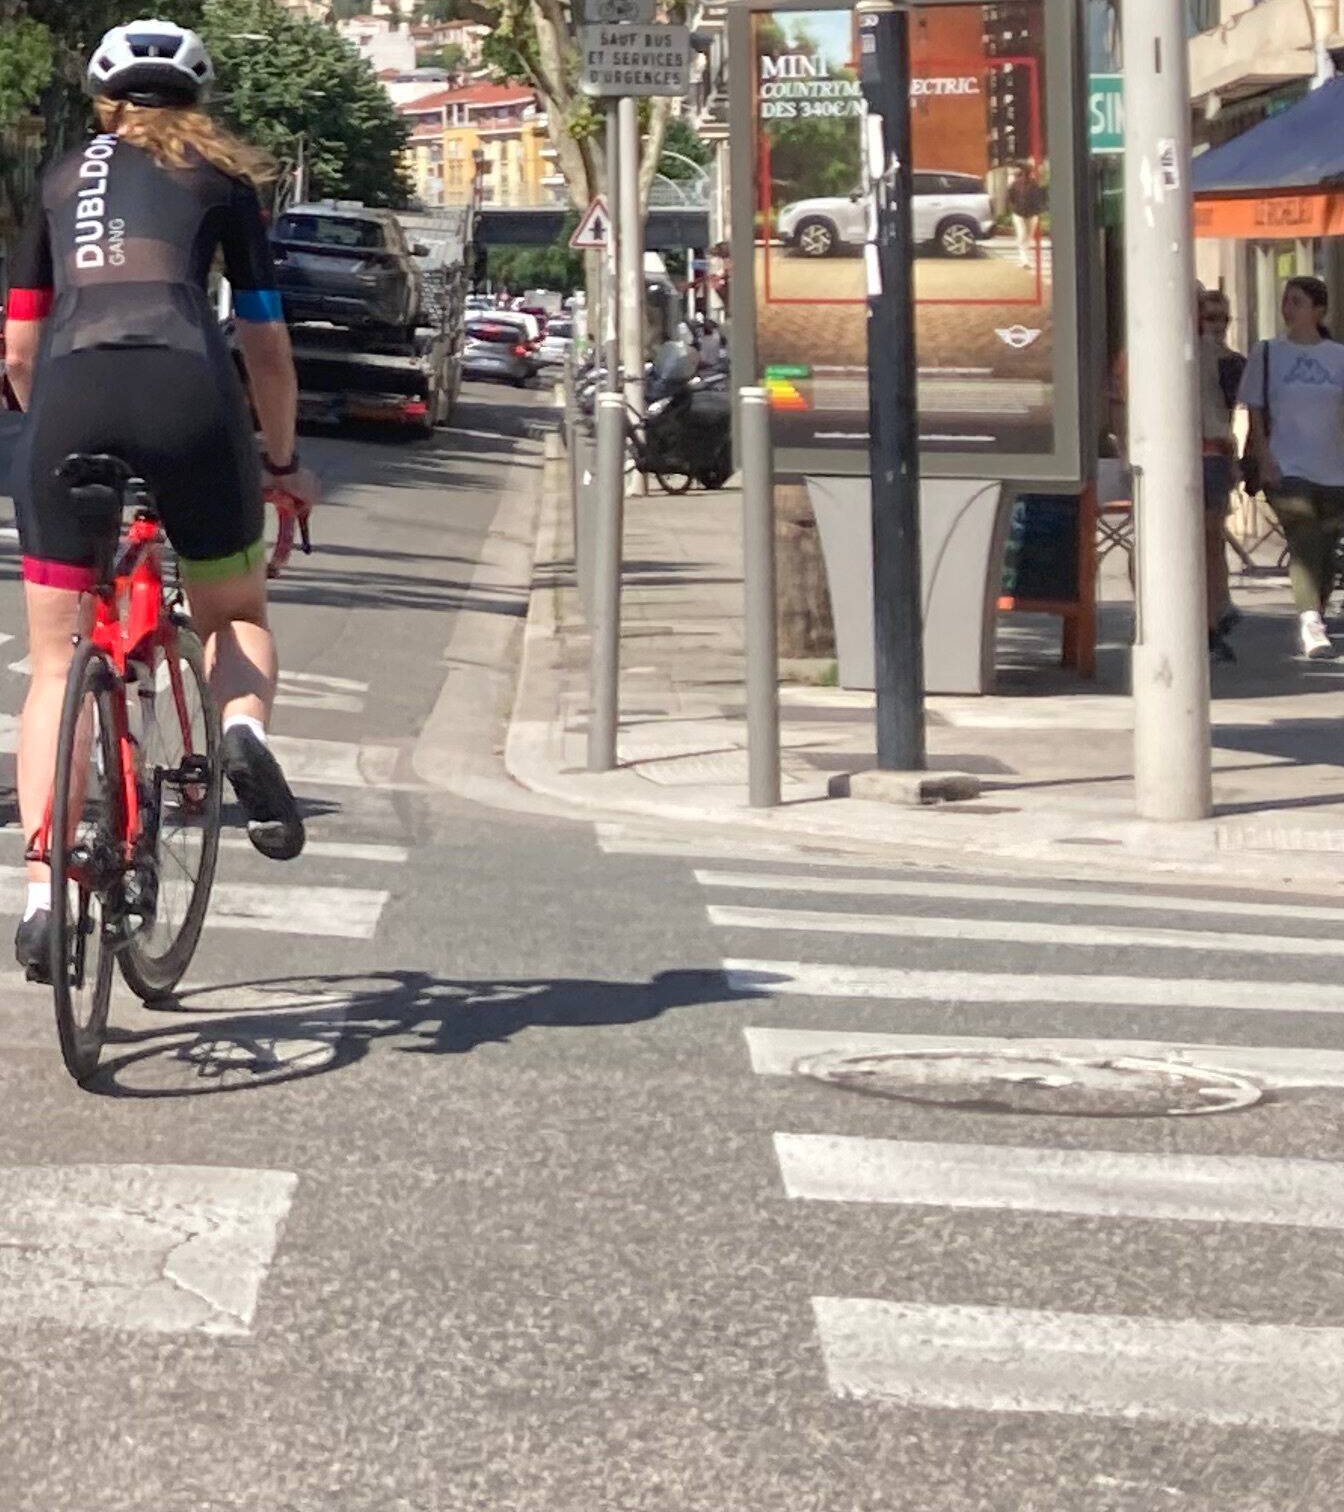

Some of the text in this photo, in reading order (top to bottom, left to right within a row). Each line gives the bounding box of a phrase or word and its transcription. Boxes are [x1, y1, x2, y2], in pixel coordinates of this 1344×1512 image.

[600, 32, 672, 47] SAUF BUS
[588, 51, 683, 67] ET SERVICES
[761, 55, 829, 79] MINI
[760, 77, 980, 98] COUNTRYM ECTRIC.
